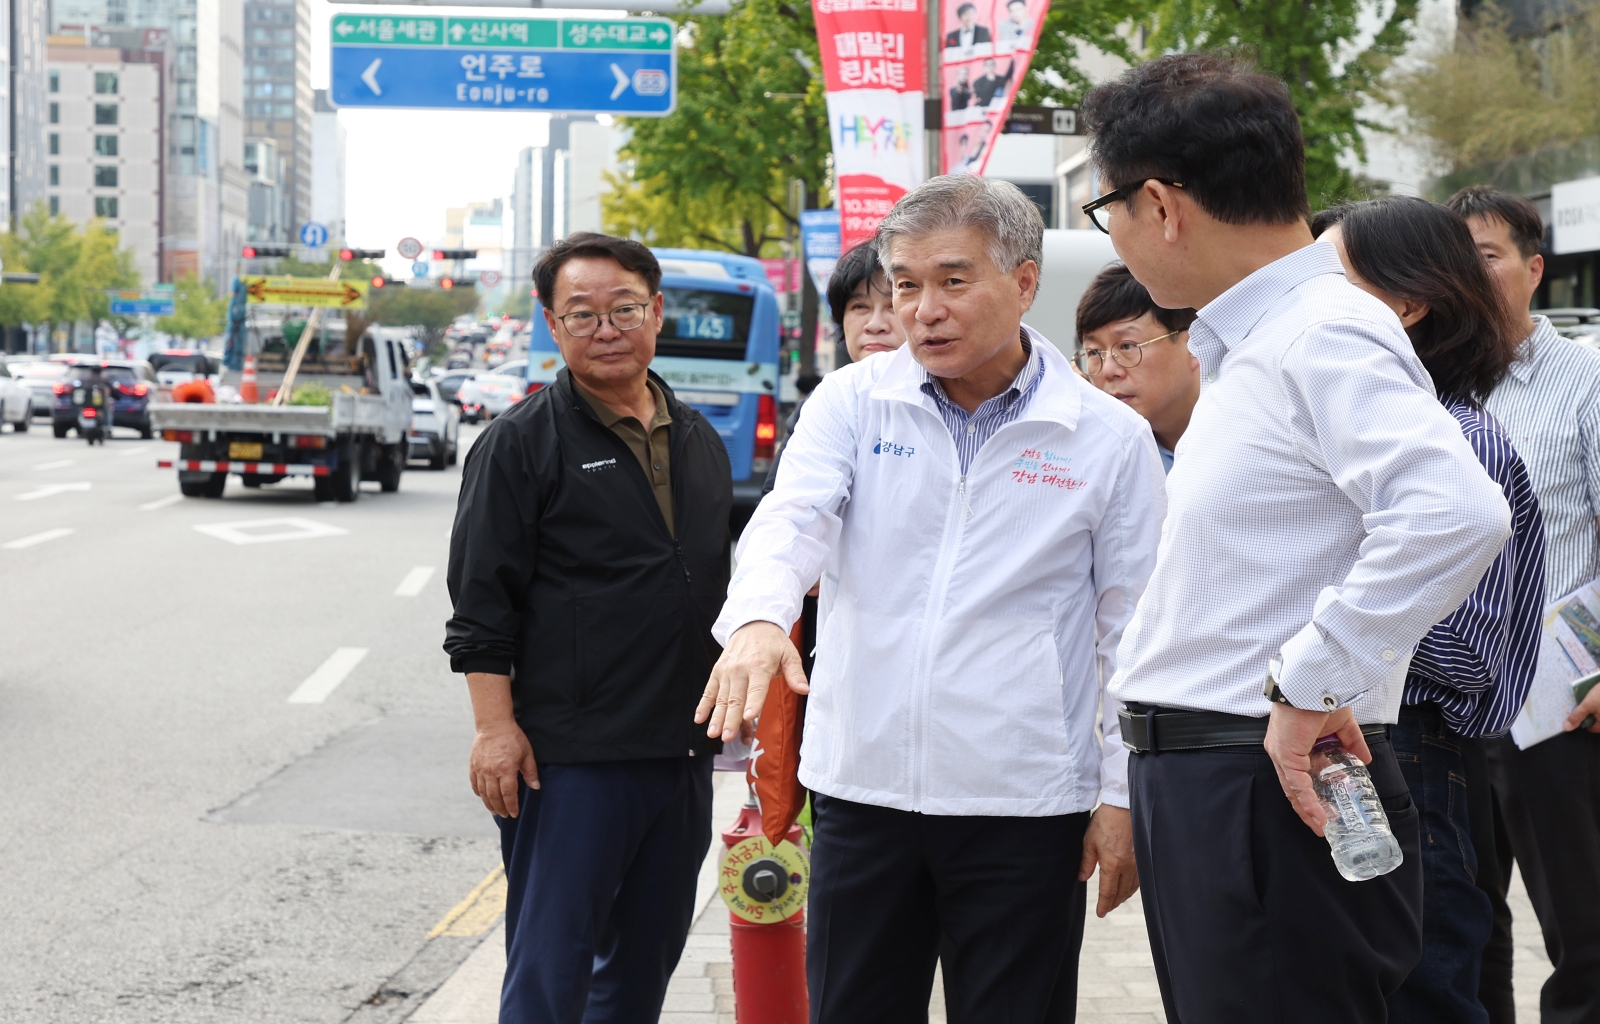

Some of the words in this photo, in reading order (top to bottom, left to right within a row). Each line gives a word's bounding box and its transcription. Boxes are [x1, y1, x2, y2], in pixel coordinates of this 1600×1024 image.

[356, 19, 438, 42] 서울세관
[468, 22, 529, 44] 신사역
[567, 23, 649, 44] 성수대교
[833, 31, 904, 60] 패밀리
[460, 55, 545, 82] 언주로
[837, 59, 906, 88] 콘서트
[456, 84, 549, 104] Eonju-ro
[839, 114, 886, 157] HEY
[688, 317, 725, 339] 145
[882, 441, 915, 458] 강남구
[1014, 459, 1038, 470] 구민을
[1041, 462, 1071, 474] 신나게!
[1011, 470, 1039, 484] 강남
[1041, 474, 1088, 490] 대전환!!
[730, 895, 747, 910] 이내
